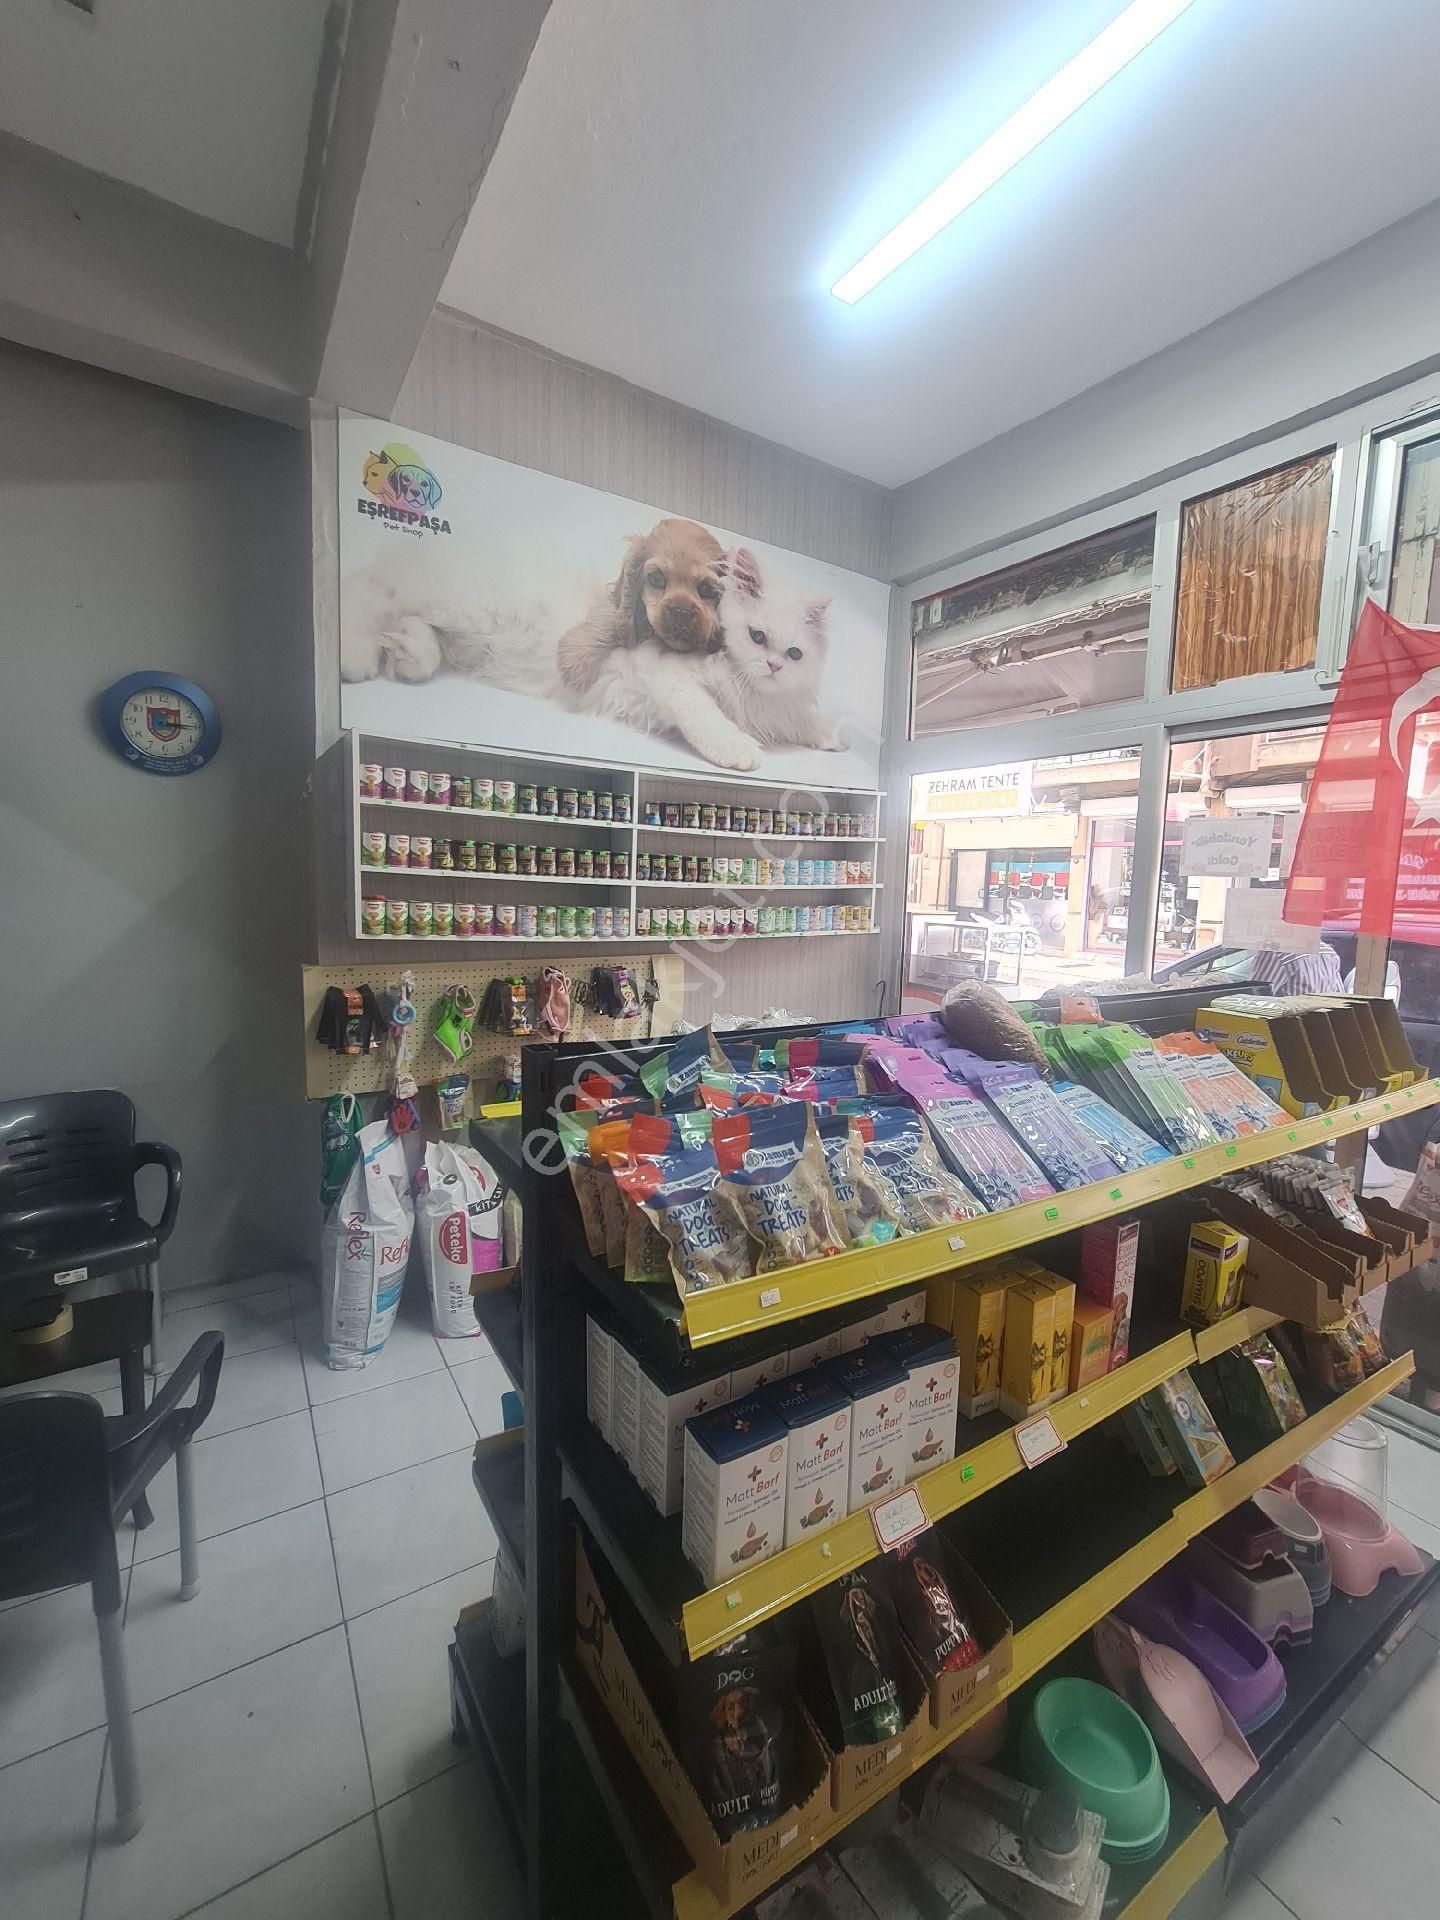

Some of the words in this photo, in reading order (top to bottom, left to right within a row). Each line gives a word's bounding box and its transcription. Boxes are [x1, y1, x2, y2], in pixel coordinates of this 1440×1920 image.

[357, 498, 452, 536] EŞREFPAŞA
[928, 779, 977, 793] ZEHRAM
[981, 772, 1020, 788] TENTE
[749, 1182, 793, 1202] NATURAL
[667, 1198, 717, 1223] NATURAL
[765, 1198, 793, 1216] DOG
[347, 1212, 371, 1261] Reflex
[683, 1211, 713, 1234] DOG
[757, 1209, 807, 1236] TREATS
[450, 1217, 462, 1263] Peteko
[679, 1226, 730, 1256] TREATS
[1193, 1259, 1207, 1306] SHAMPOO
[908, 1397, 932, 1411] Matt
[933, 1387, 953, 1404] Barf
[859, 1423, 882, 1441] Matt
[883, 1412, 903, 1430] Barf
[795, 1453, 822, 1473] Matt
[823, 1440, 844, 1462] Barf
[726, 1486, 755, 1507] Matt
[756, 1472, 781, 1494] Barf
[853, 1684, 889, 1712] ADULT
